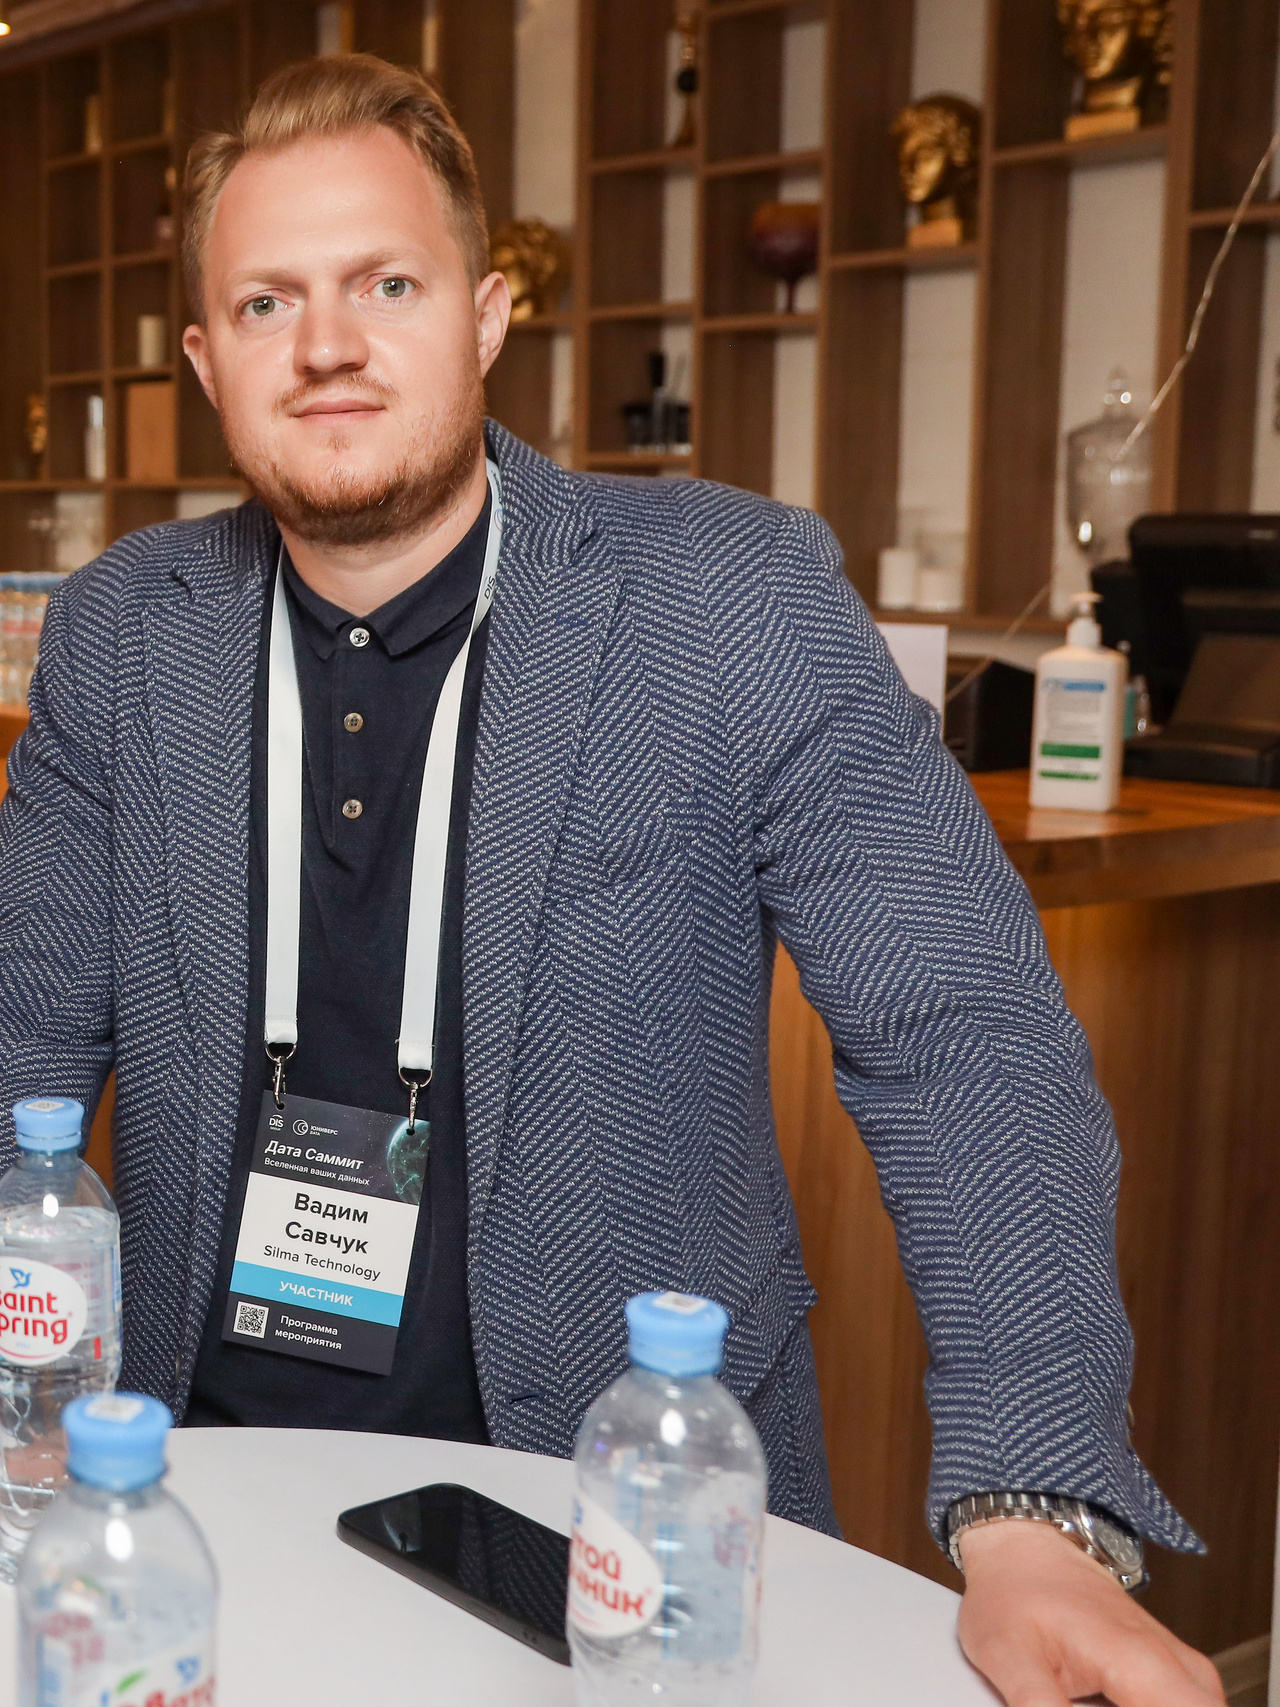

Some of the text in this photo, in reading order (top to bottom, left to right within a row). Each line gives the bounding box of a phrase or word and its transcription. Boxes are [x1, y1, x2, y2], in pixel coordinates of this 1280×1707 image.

[485, 575, 496, 600] DIS
[268, 1117, 284, 1128] DIS
[310, 1125, 339, 1136] ЮНИВЕРС
[264, 1139, 365, 1171] Дата Саммит
[264, 1157, 371, 1187] Вселенная ваших данных
[294, 1192, 369, 1224] Вадим
[285, 1221, 369, 1254] Савчук
[263, 1245, 381, 1282] Silma Technology
[278, 1280, 354, 1307] УЧАСТНИК
[280, 1315, 339, 1336] Программа
[274, 1329, 343, 1350] мероприятия
